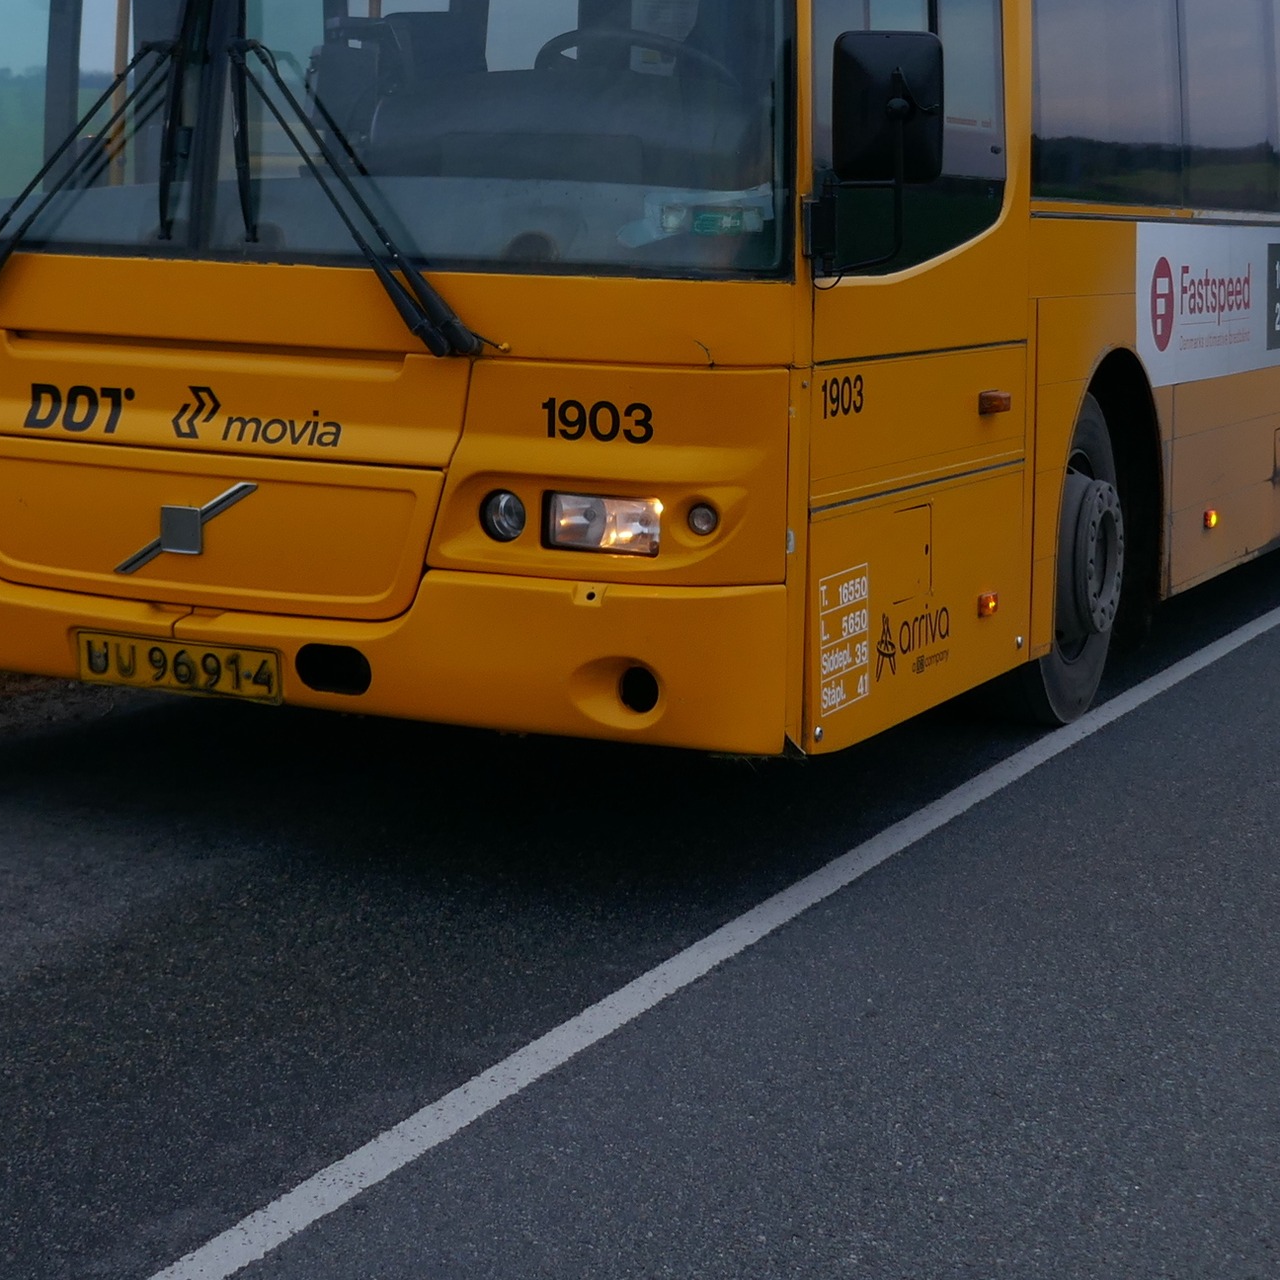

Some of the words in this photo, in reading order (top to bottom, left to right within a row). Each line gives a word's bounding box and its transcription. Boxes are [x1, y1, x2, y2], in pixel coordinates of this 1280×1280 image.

[1180, 262, 1251, 326] Fastspeed
[23, 383, 131, 434] DOT
[821, 374, 865, 420] 1903
[221, 410, 342, 448] movia
[541, 397, 654, 445] 1903
[820, 585, 829, 607] T.
[839, 575, 868, 605] 16550
[822, 620, 830, 641] L.
[841, 608, 868, 637] 5650
[899, 603, 950, 655] arriva
[855, 641, 868, 664] 35
